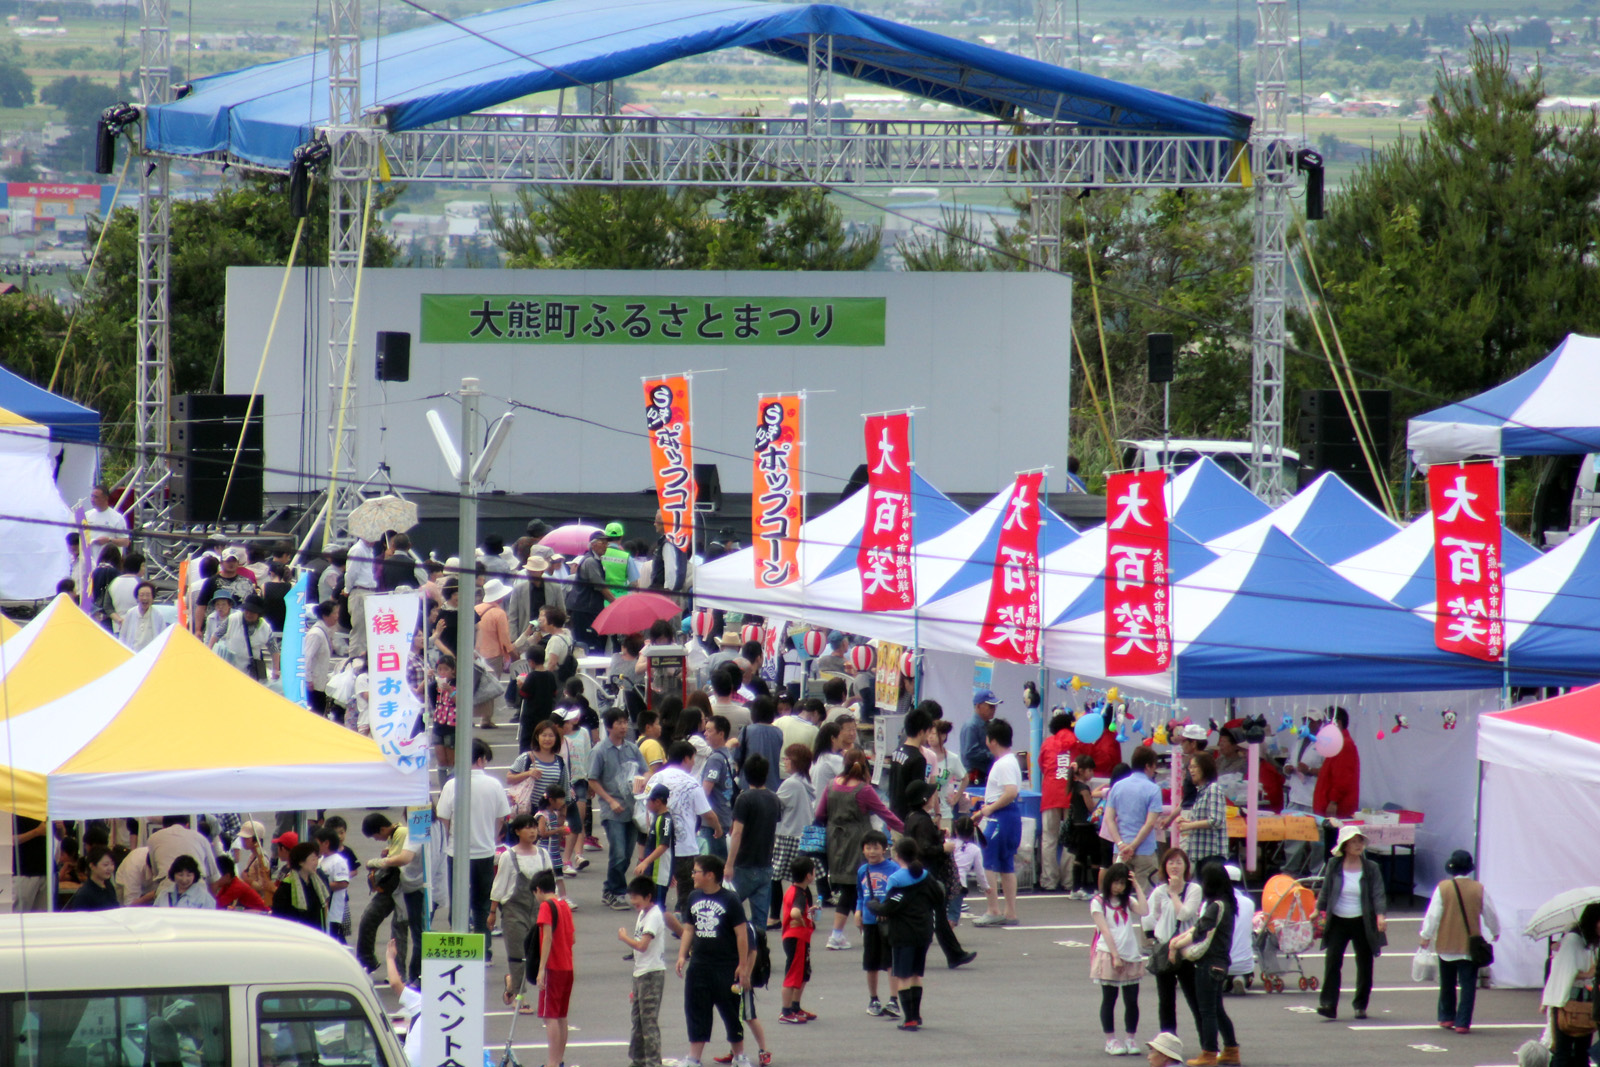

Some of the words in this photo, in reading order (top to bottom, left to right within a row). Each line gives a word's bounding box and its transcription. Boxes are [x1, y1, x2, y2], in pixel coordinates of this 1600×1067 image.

[468, 301, 834, 339] 大熊町ふるさとまつり
[759, 442, 792, 585] ポップコーン
[707, 769, 719, 780] 29
[439, 936, 464, 947] 大熊町
[426, 948, 477, 959] ふるさとまつり
